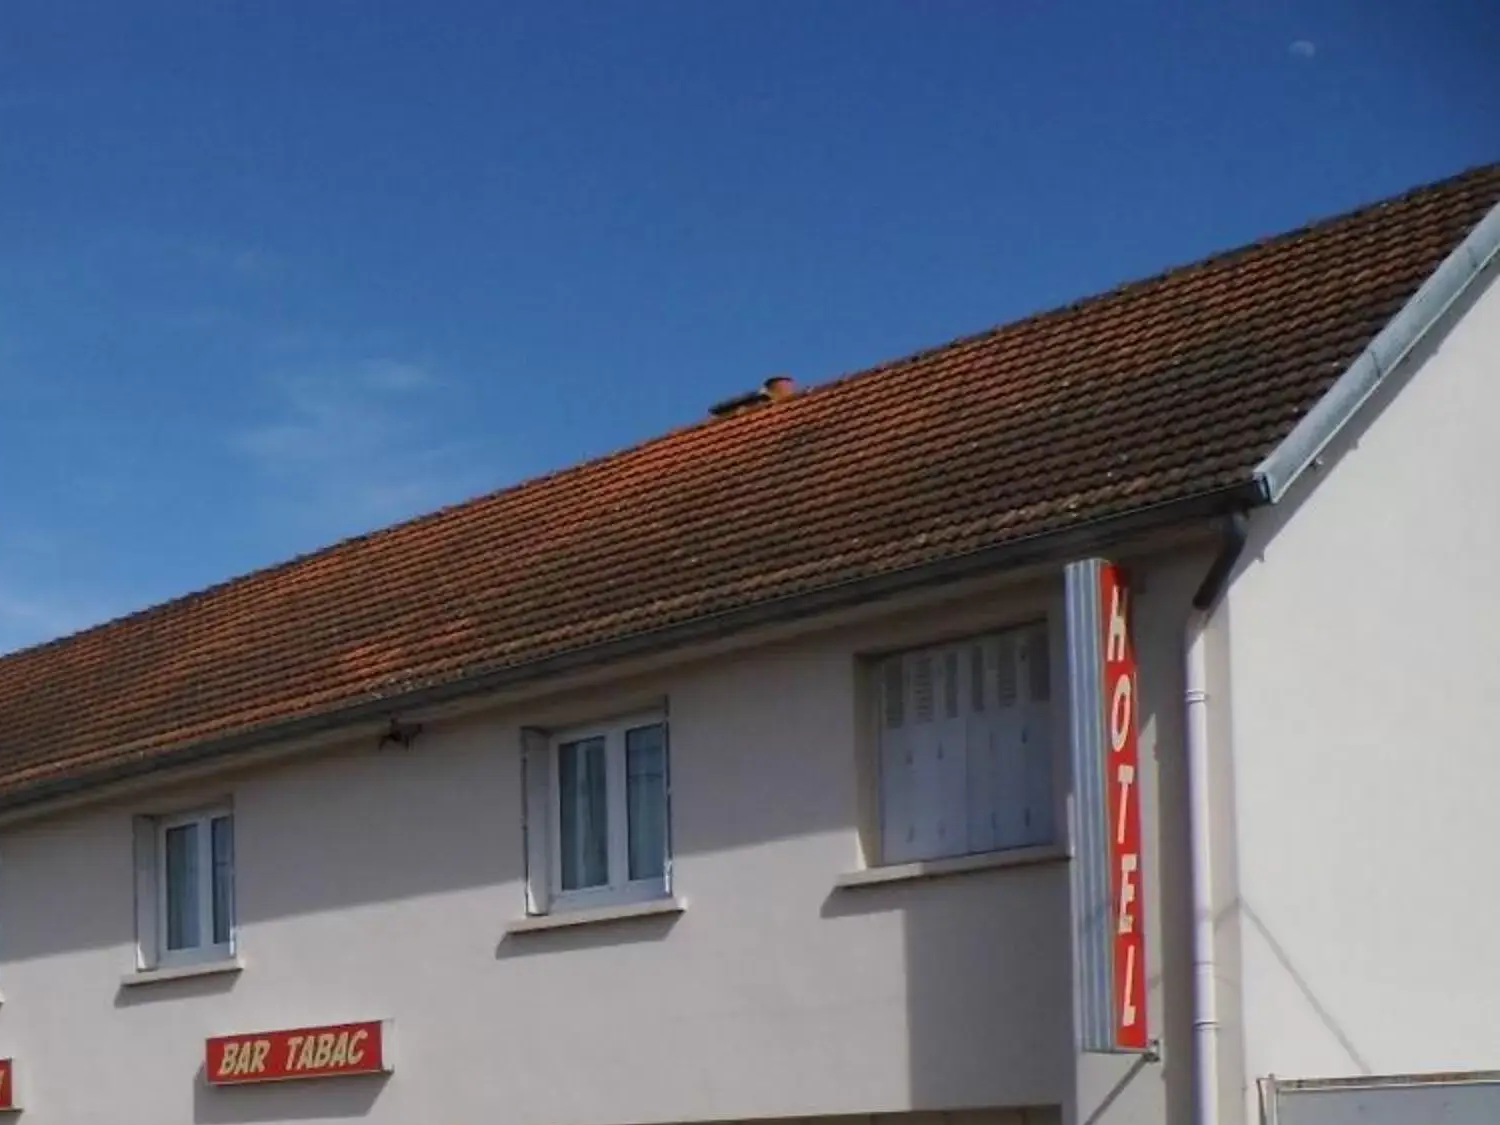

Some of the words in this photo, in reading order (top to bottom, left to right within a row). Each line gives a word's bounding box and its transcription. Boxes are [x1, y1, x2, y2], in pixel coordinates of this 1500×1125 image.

[1106, 584, 1136, 1027] HOTEL
[216, 1038, 271, 1077] BAR
[285, 1029, 368, 1072] TABAC
